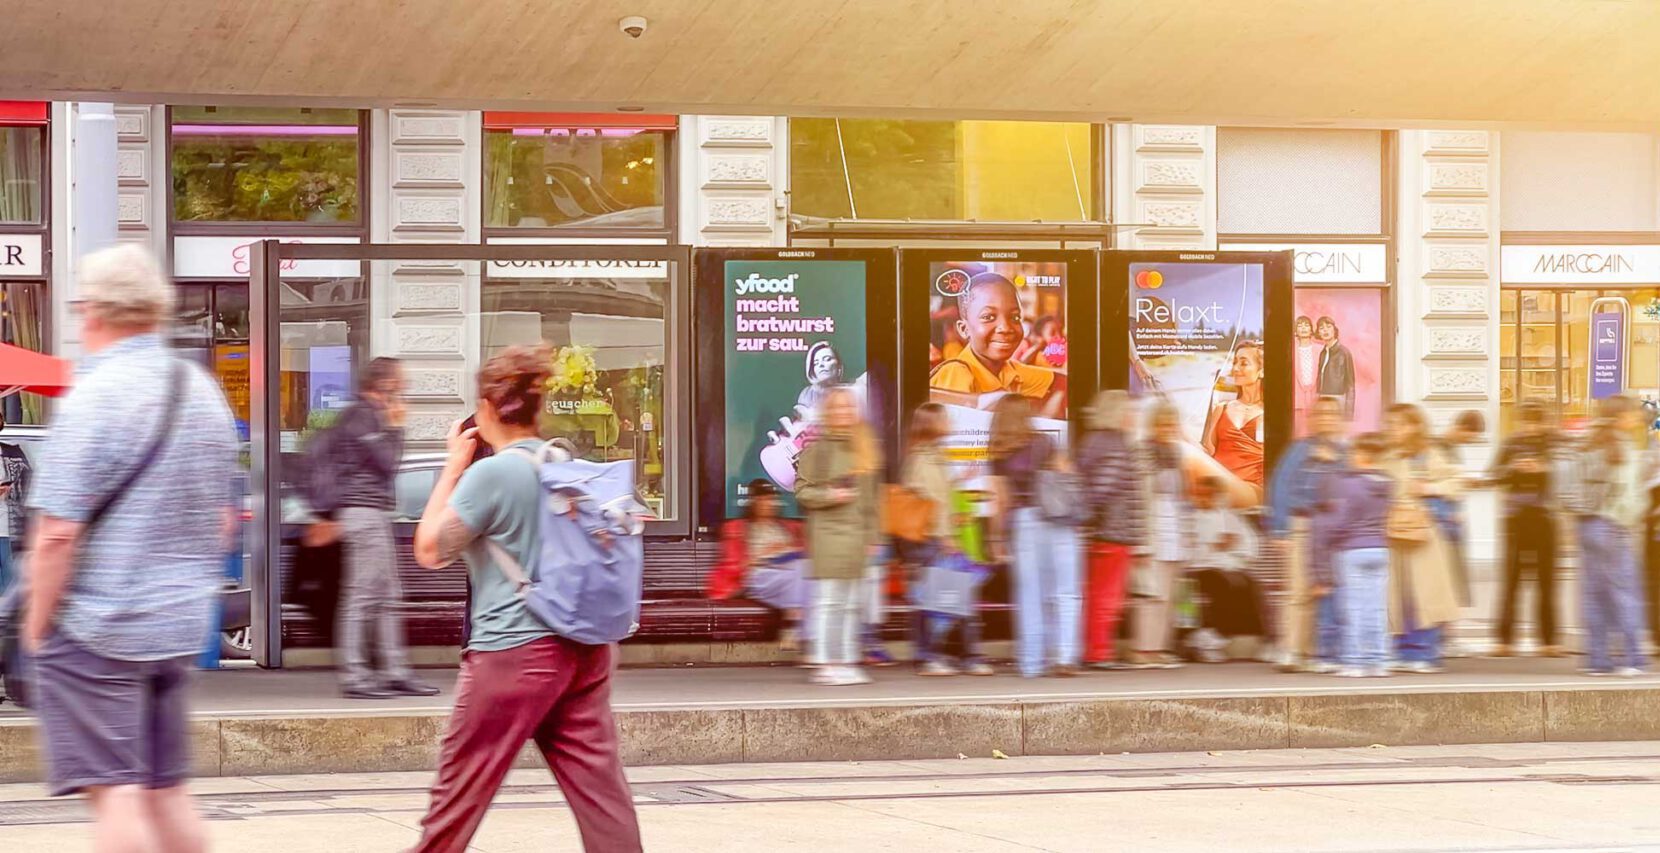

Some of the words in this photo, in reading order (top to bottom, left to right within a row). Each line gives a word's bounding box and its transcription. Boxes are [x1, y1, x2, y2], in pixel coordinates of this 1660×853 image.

[0, 245, 25, 266] R
[735, 273, 798, 295] yfood
[736, 294, 800, 312] macht
[1135, 298, 1230, 323] Relaxt.
[736, 314, 834, 333] bratwurst
[736, 338, 767, 351] zur
[768, 338, 809, 351] sau.
